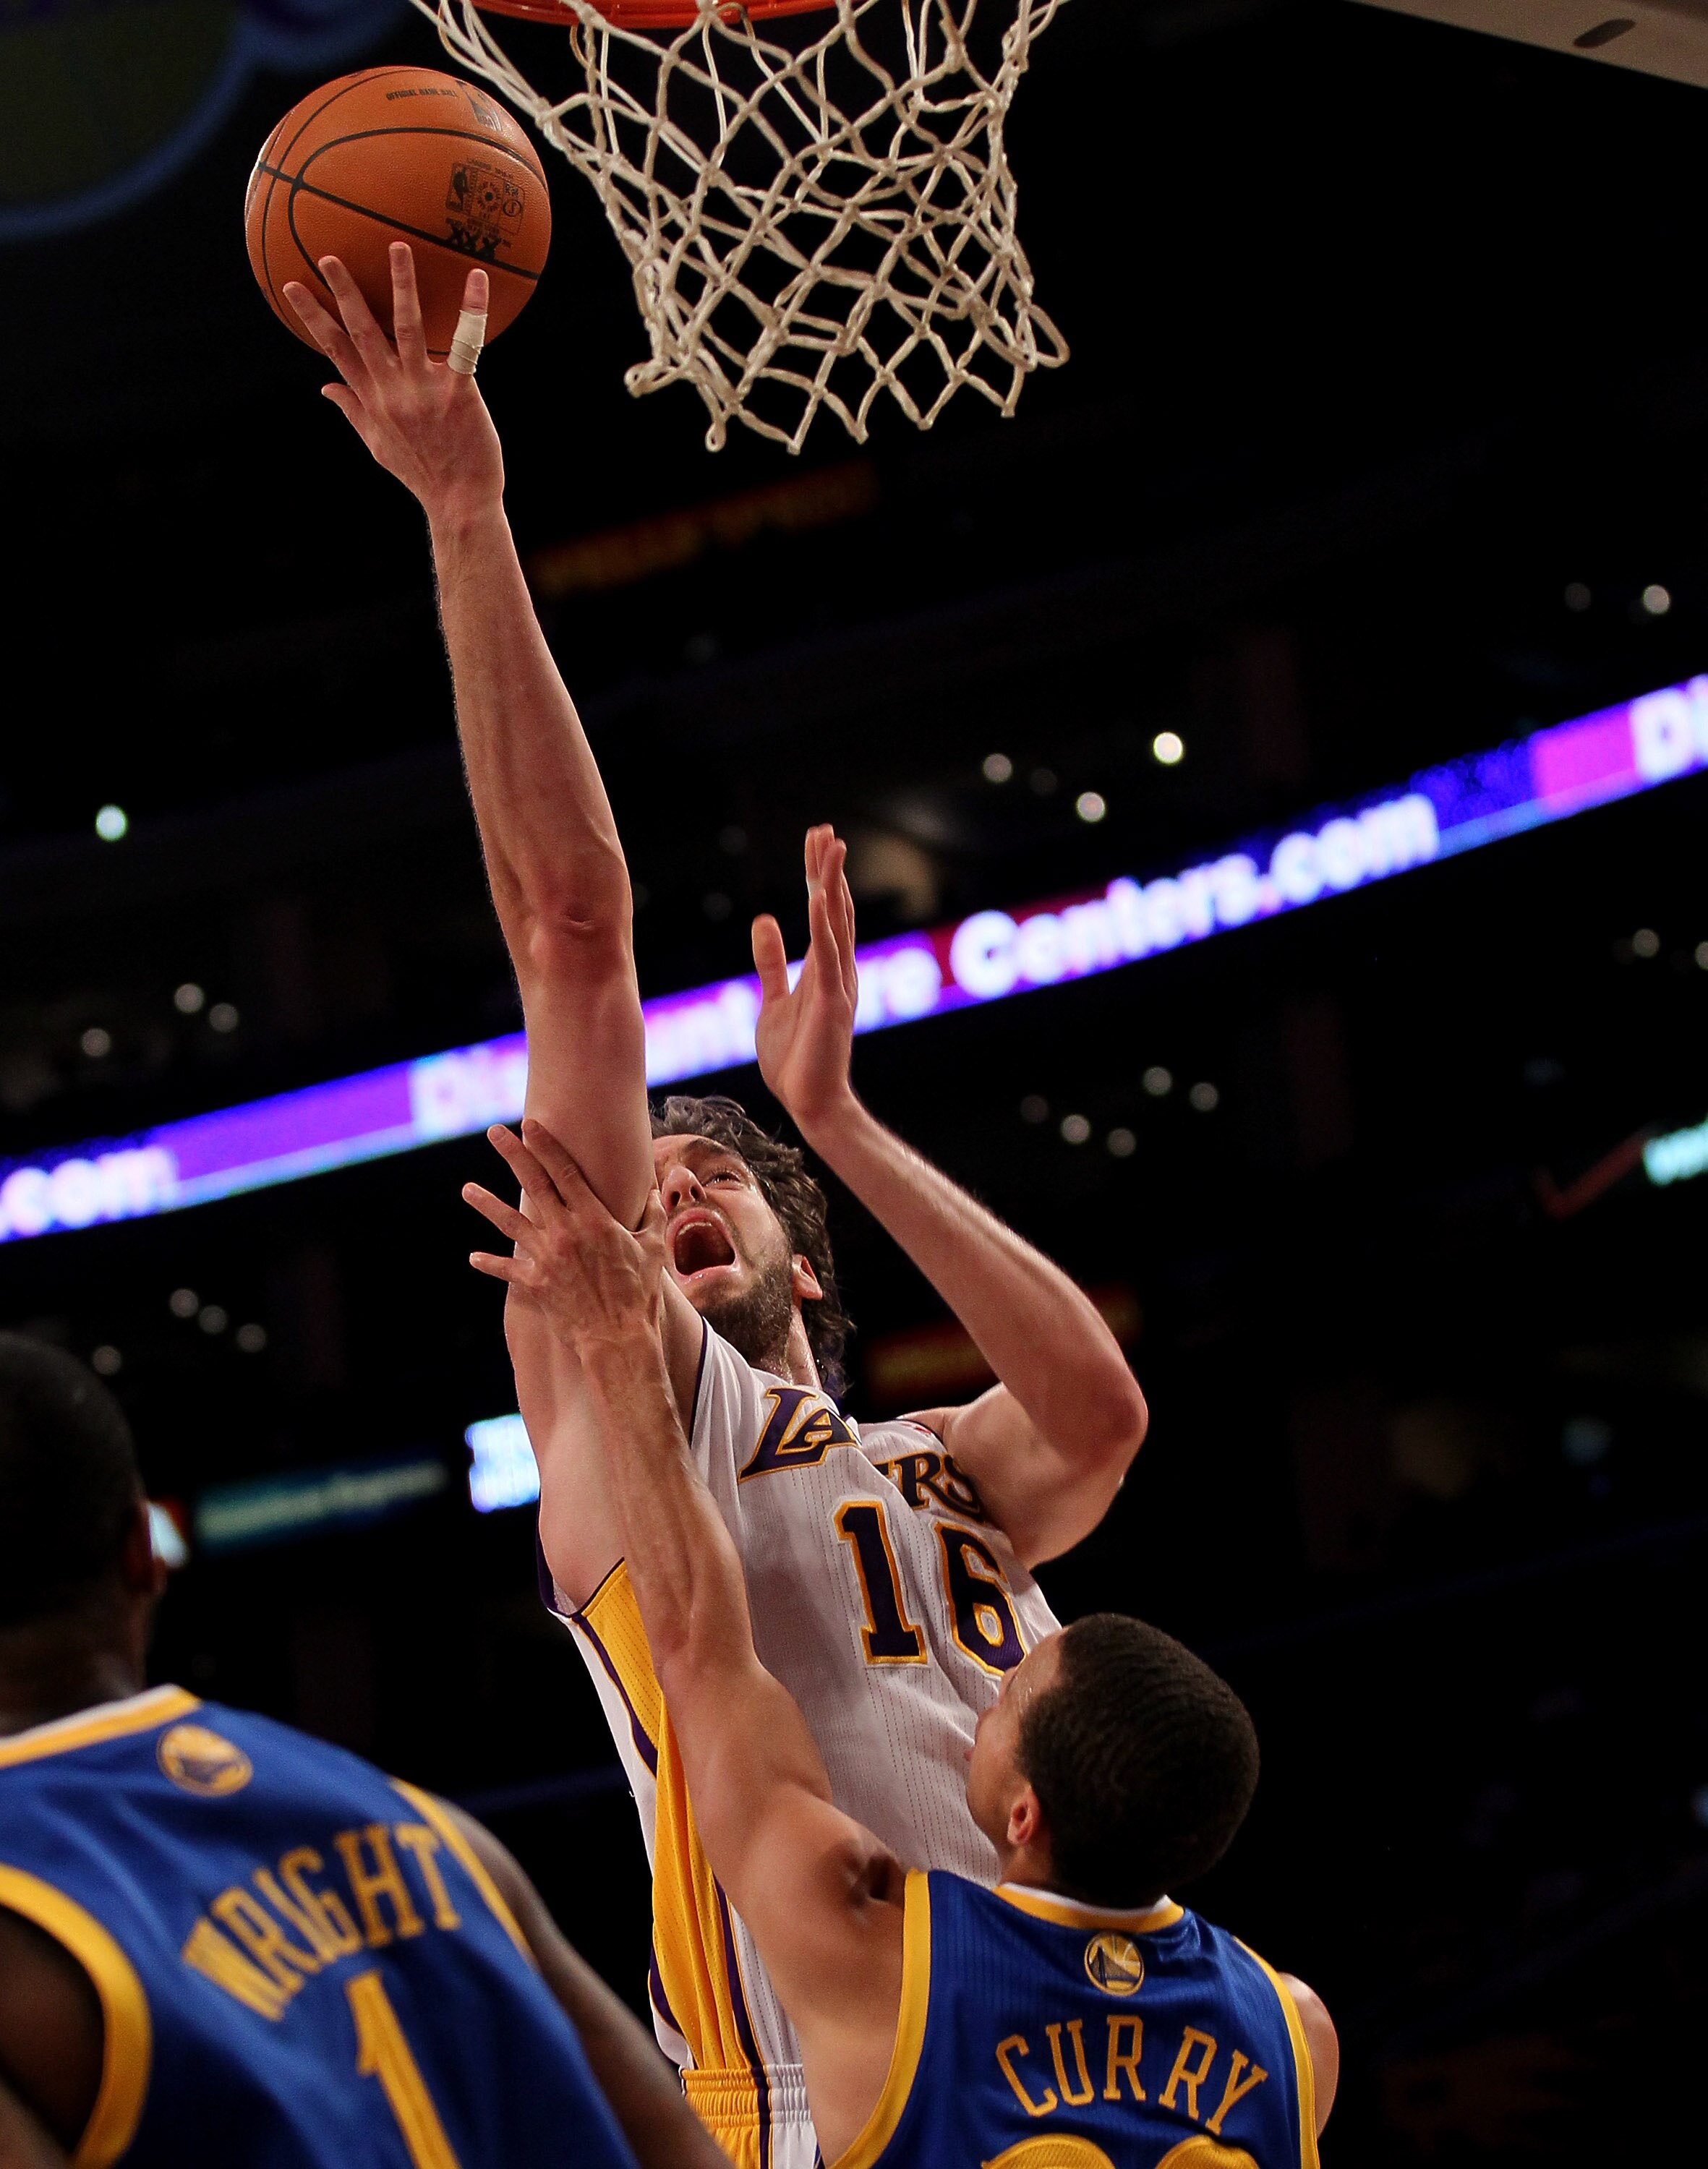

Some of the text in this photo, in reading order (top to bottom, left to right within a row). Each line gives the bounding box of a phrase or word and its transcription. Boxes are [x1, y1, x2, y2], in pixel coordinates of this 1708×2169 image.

[949, 793, 1440, 999] Centers.com
[833, 1499, 1027, 1676] 16
[182, 1822, 461, 2022] WRIGHT
[344, 1967, 464, 2169] 1
[995, 2014, 1269, 2136] CURRY
